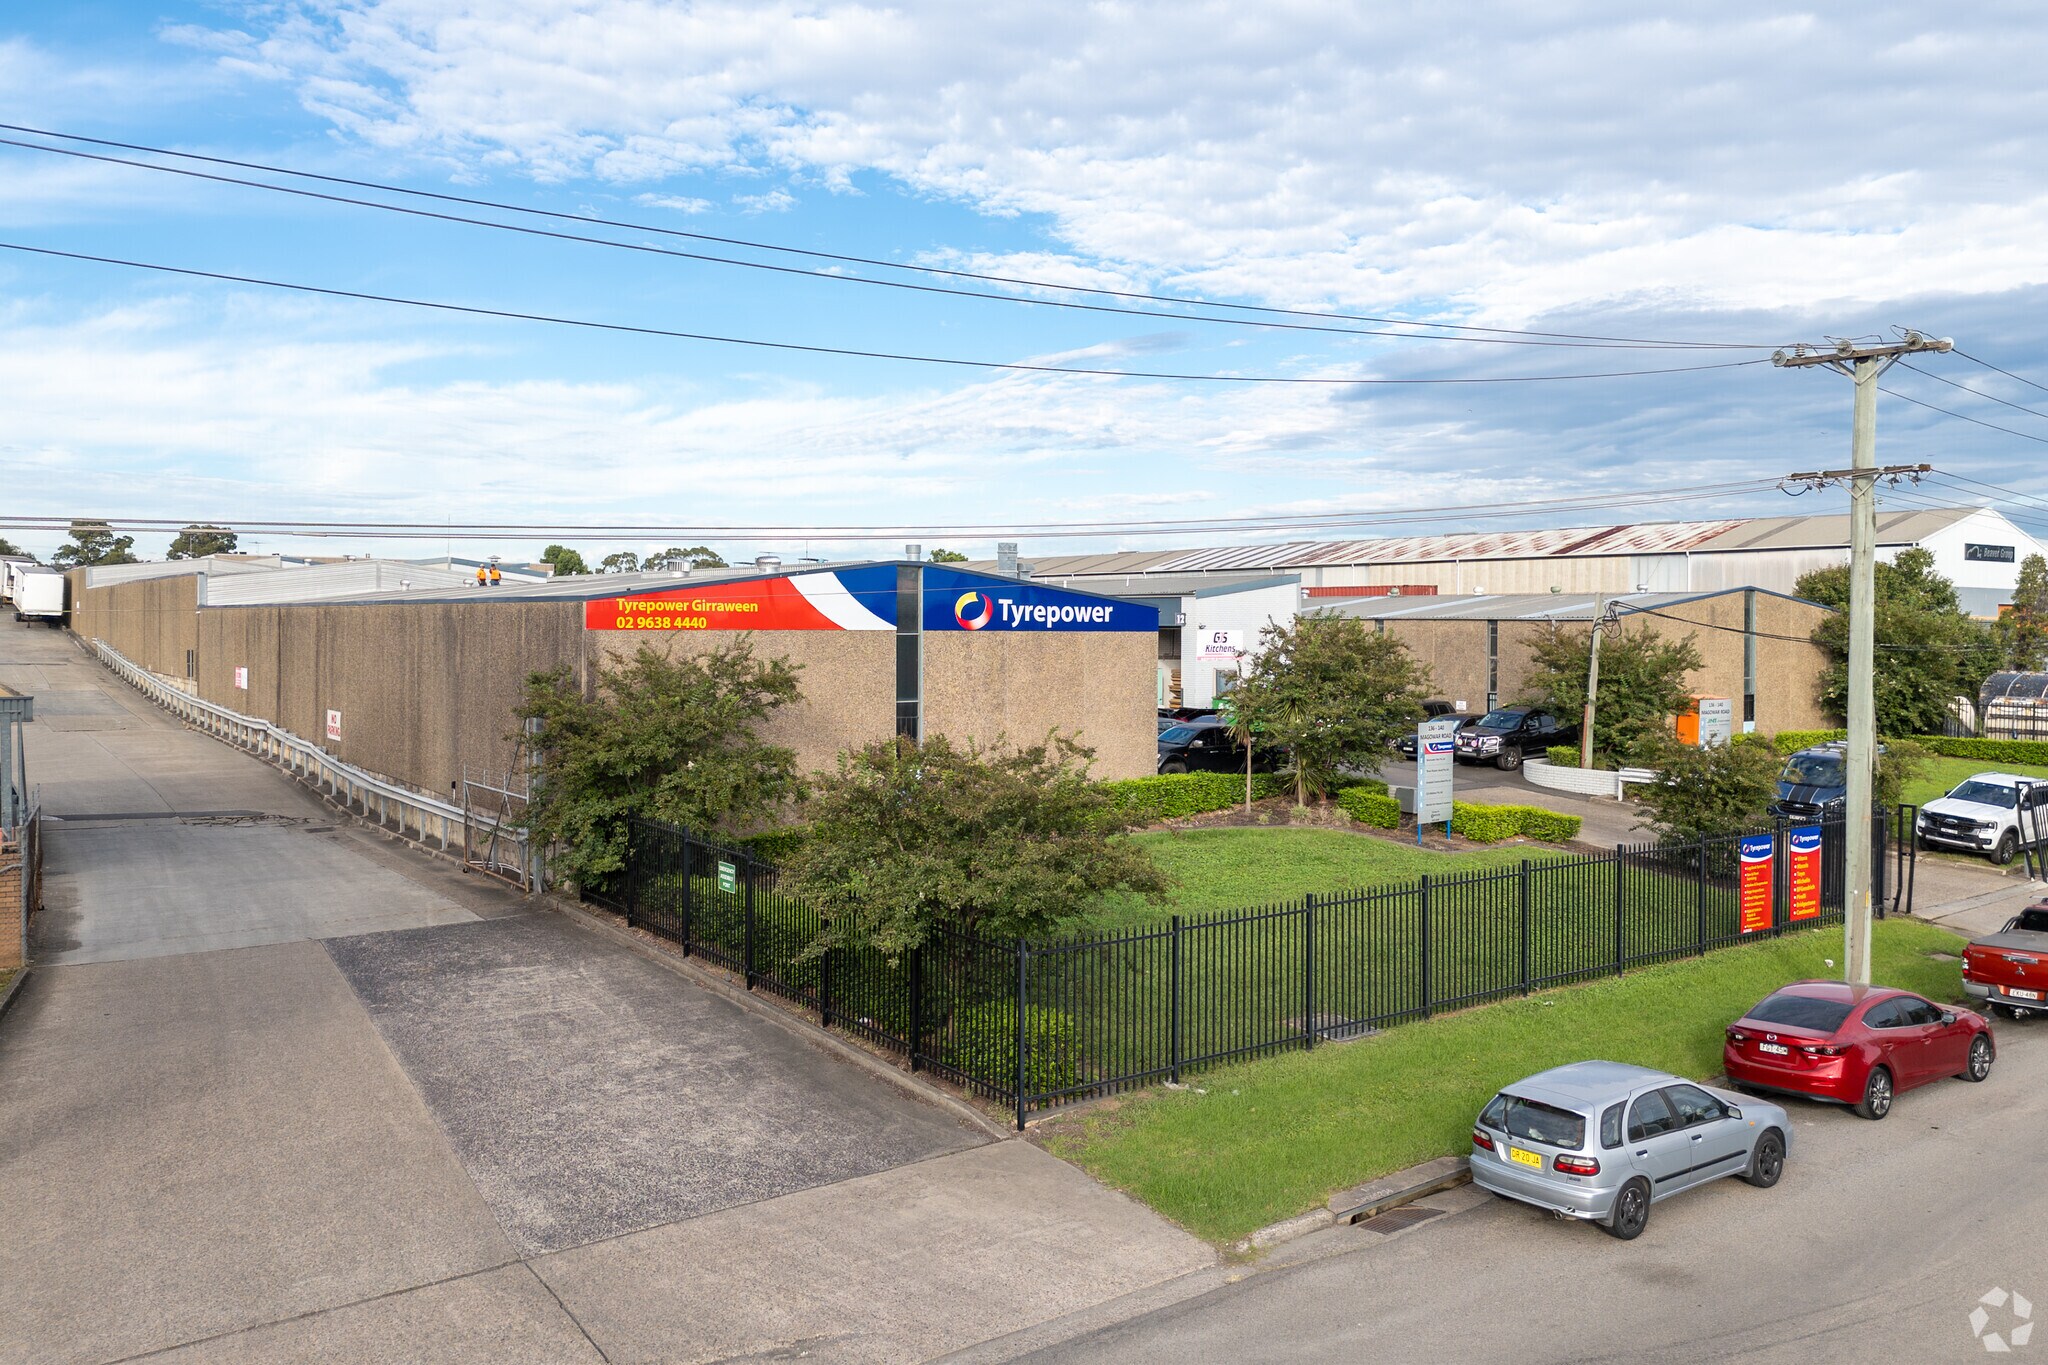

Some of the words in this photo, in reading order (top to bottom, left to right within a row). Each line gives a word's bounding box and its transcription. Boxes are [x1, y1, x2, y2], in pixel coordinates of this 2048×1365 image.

[1984, 548, 2000, 558] Beaver
[2000, 548, 2013, 560] Group
[616, 598, 690, 614] Tyrepower
[692, 600, 758, 613] Girraween
[998, 598, 1113, 628] Tyrepower
[616, 617, 634, 629] 02
[636, 617, 672, 629] 9638
[674, 617, 707, 629] 4440
[1176, 614, 1184, 624] 12
[328, 725, 340, 736] PARKING
[1800, 834, 1819, 843] Tyrepower
[1750, 844, 1770, 852] Tyrepower
[1522, 1153, 1529, 1162] 20
[1532, 1156, 1540, 1164] JA
